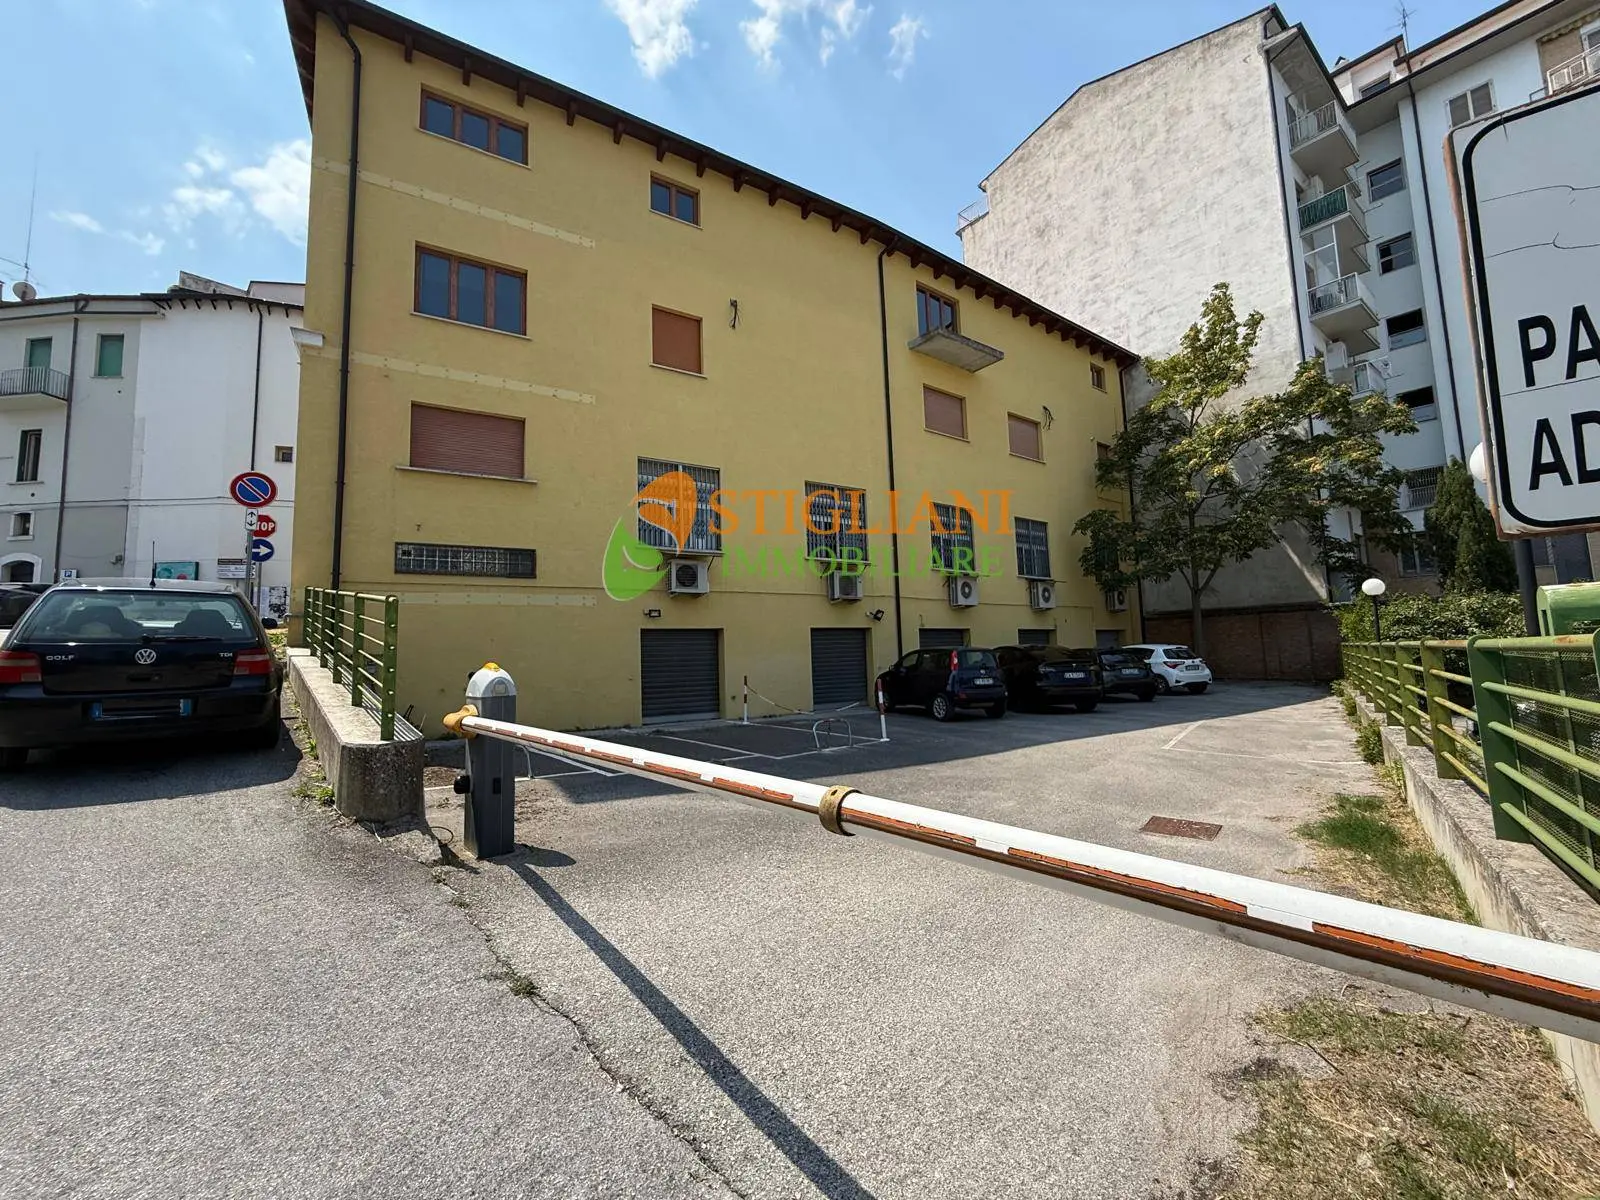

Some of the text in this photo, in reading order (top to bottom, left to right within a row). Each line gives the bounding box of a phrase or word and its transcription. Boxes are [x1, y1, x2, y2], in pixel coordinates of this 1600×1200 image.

[1518, 304, 1600, 388] PA
[1528, 410, 1600, 491] AD
[256, 521, 275, 531] TOP
